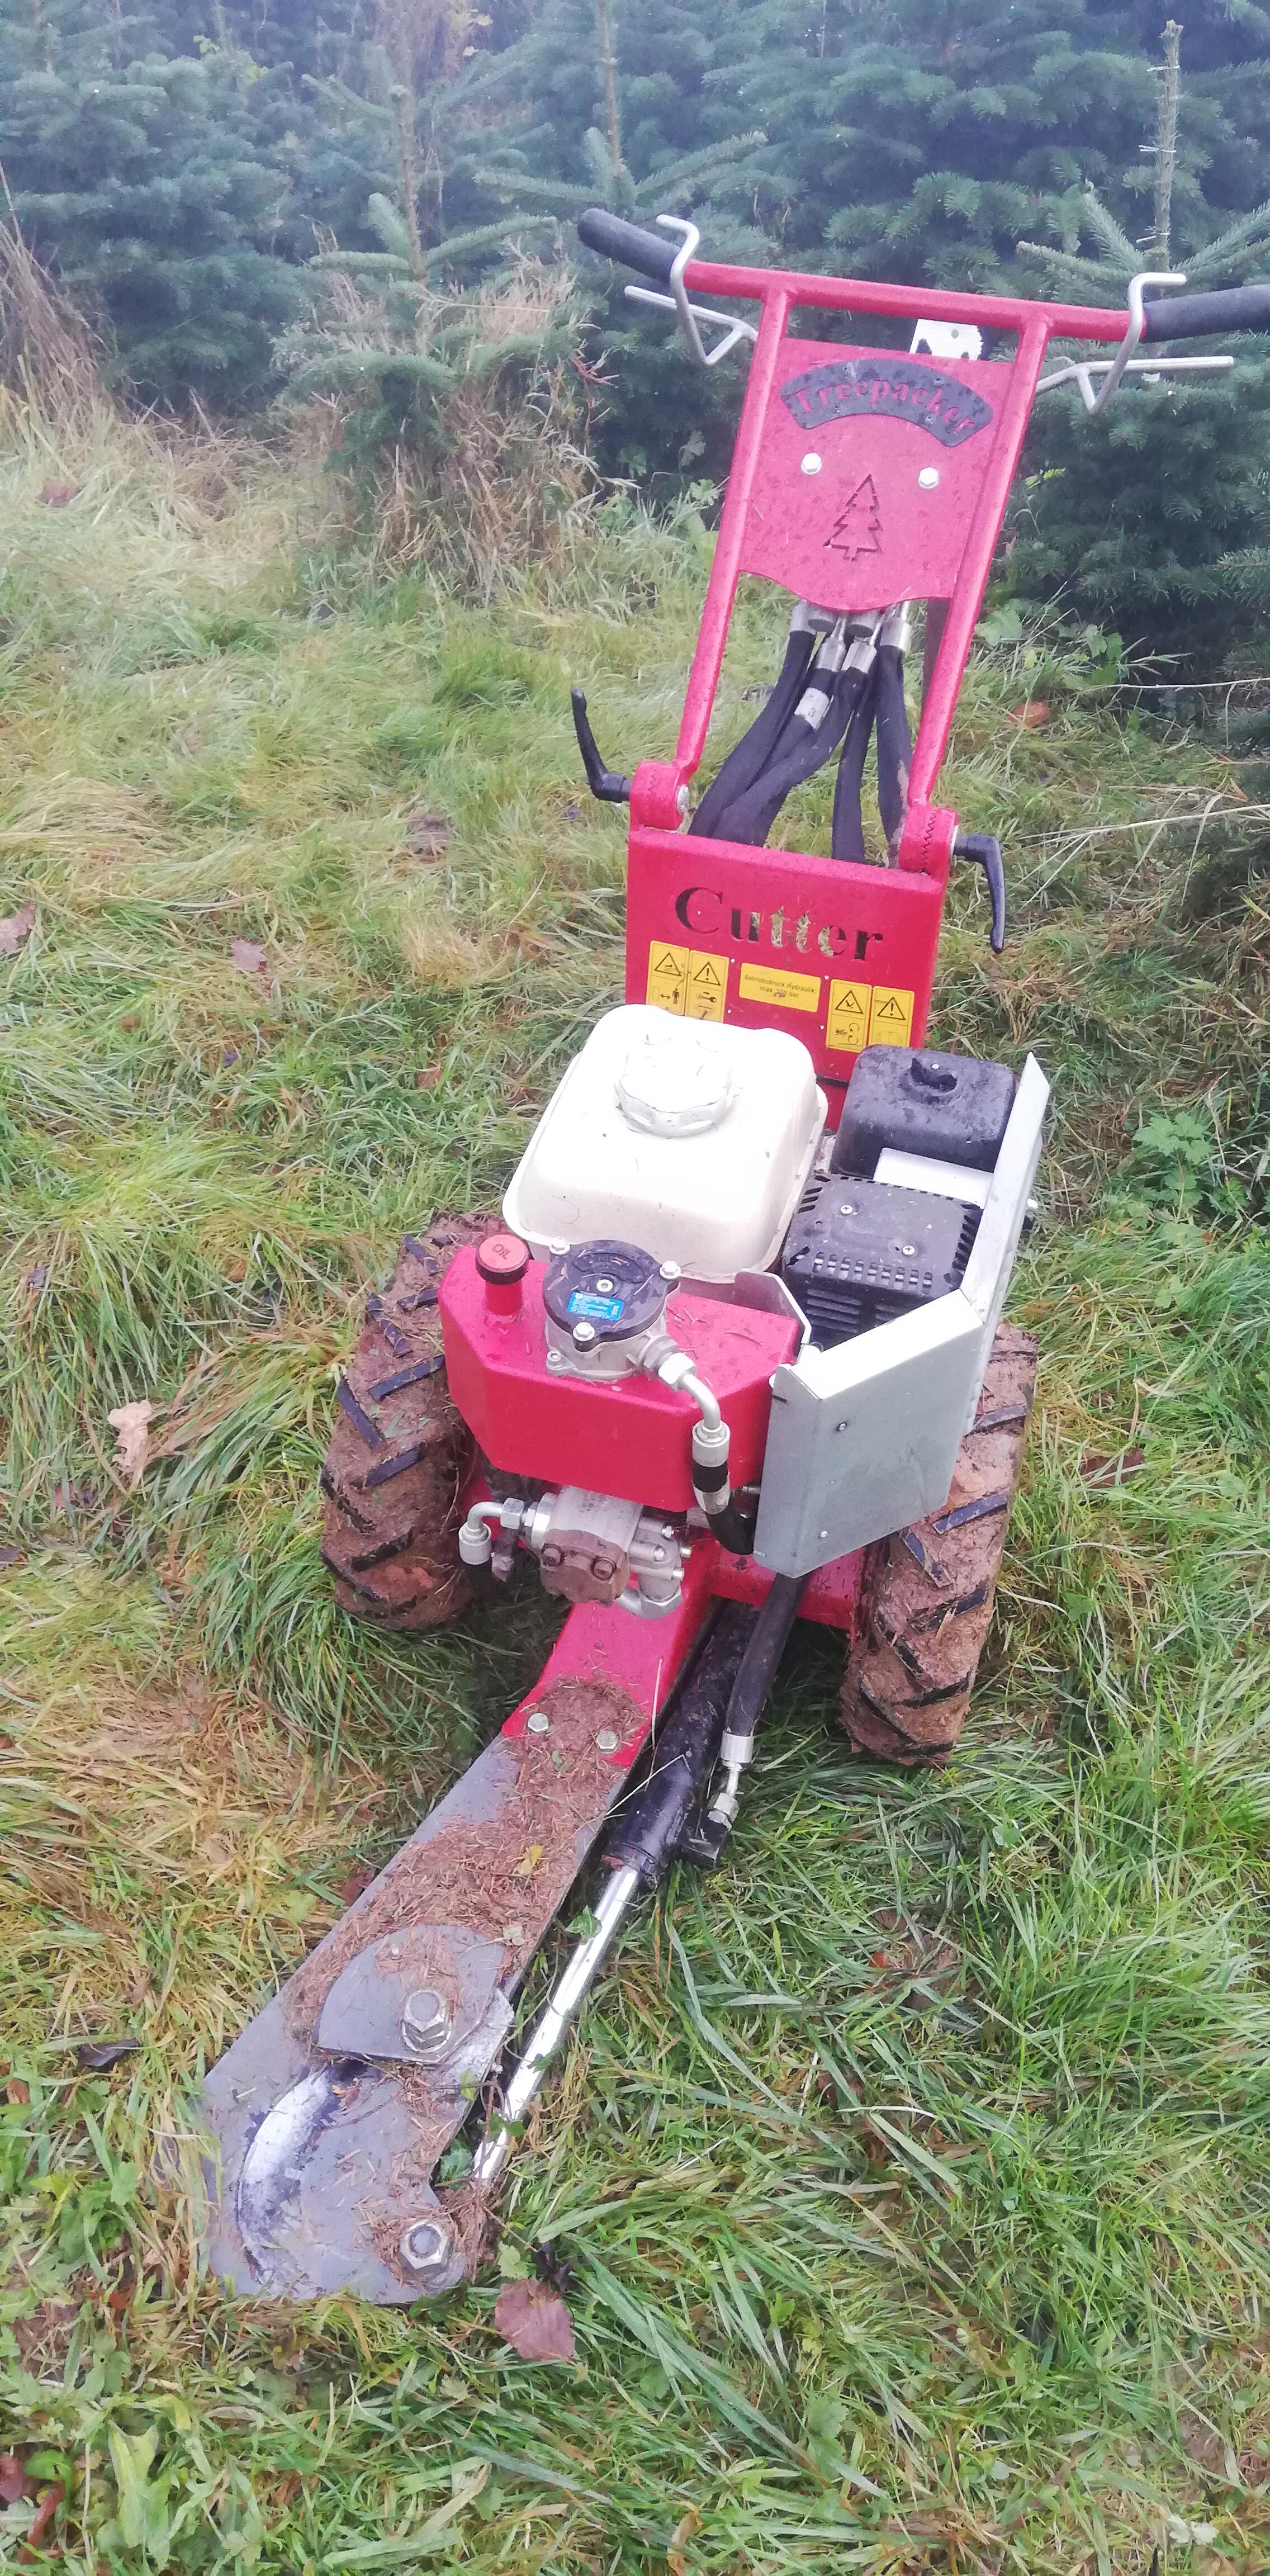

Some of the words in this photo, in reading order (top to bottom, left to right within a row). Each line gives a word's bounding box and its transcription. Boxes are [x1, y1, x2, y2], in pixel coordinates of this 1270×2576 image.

[783, 380, 975, 432] Treepacker
[675, 887, 883, 960] Cutter
[492, 1244, 511, 1259] OIL
